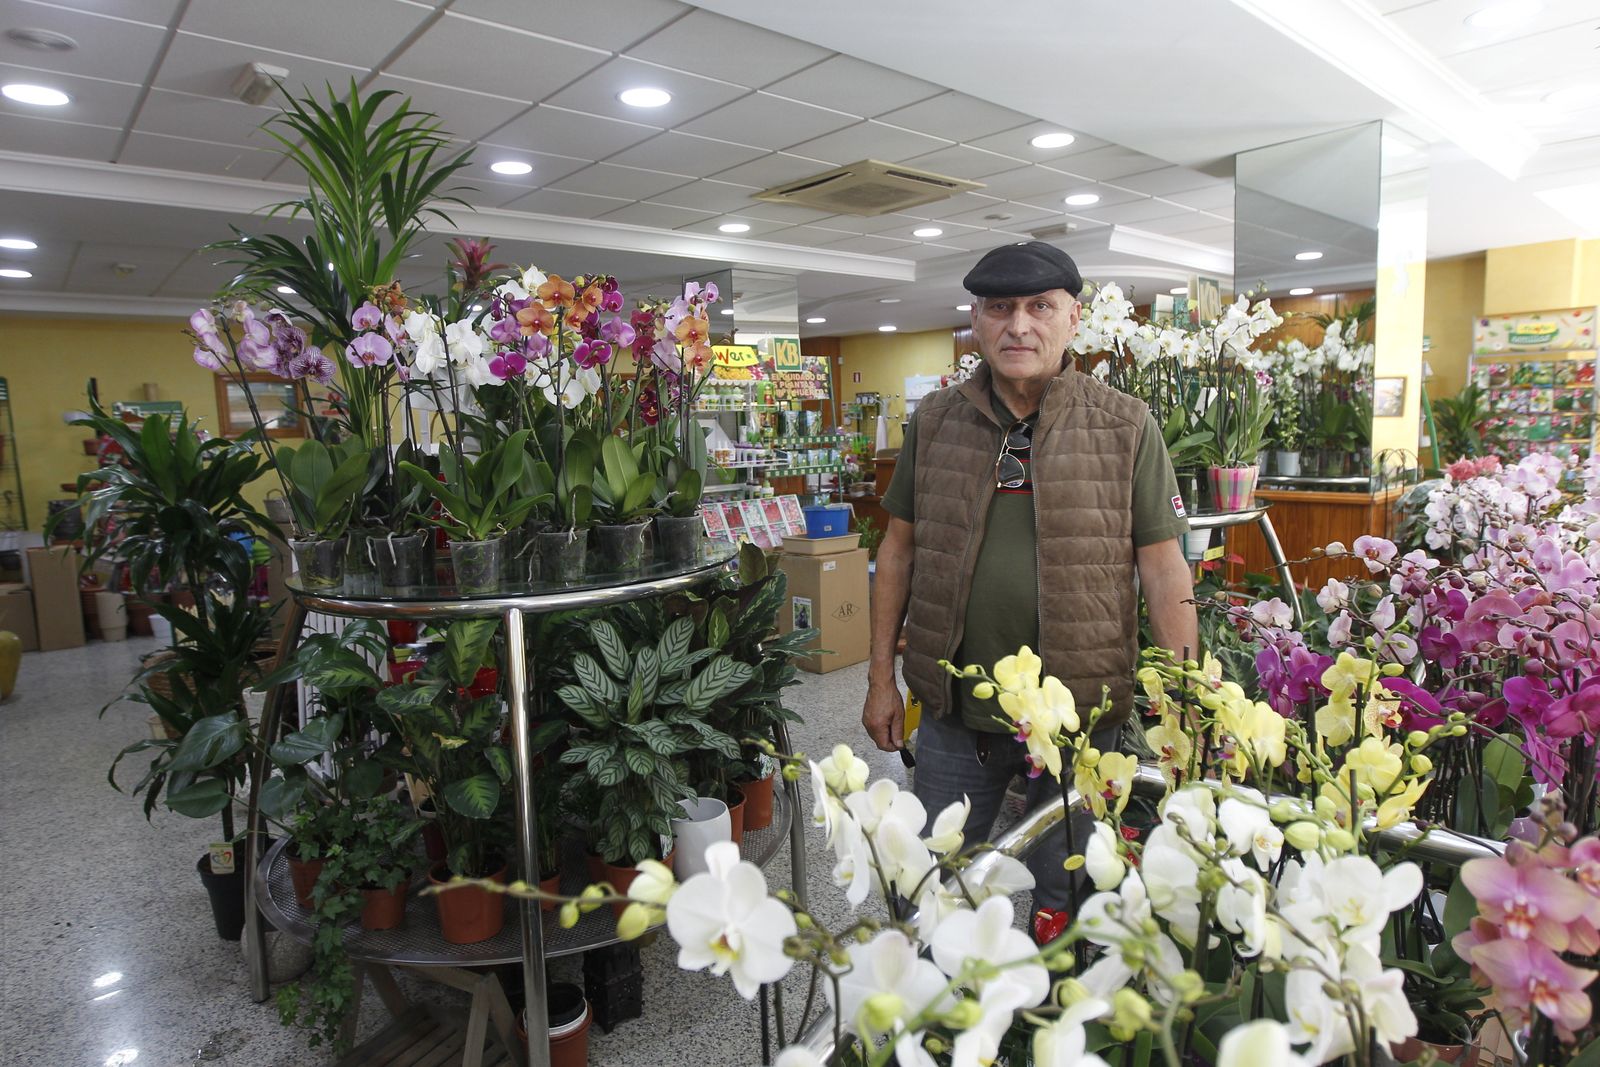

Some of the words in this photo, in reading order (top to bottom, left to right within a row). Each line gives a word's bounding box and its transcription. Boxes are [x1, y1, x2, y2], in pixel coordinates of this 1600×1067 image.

[776, 340, 799, 366] KB
[817, 373, 827, 381] DE
[839, 603, 853, 617] AR
